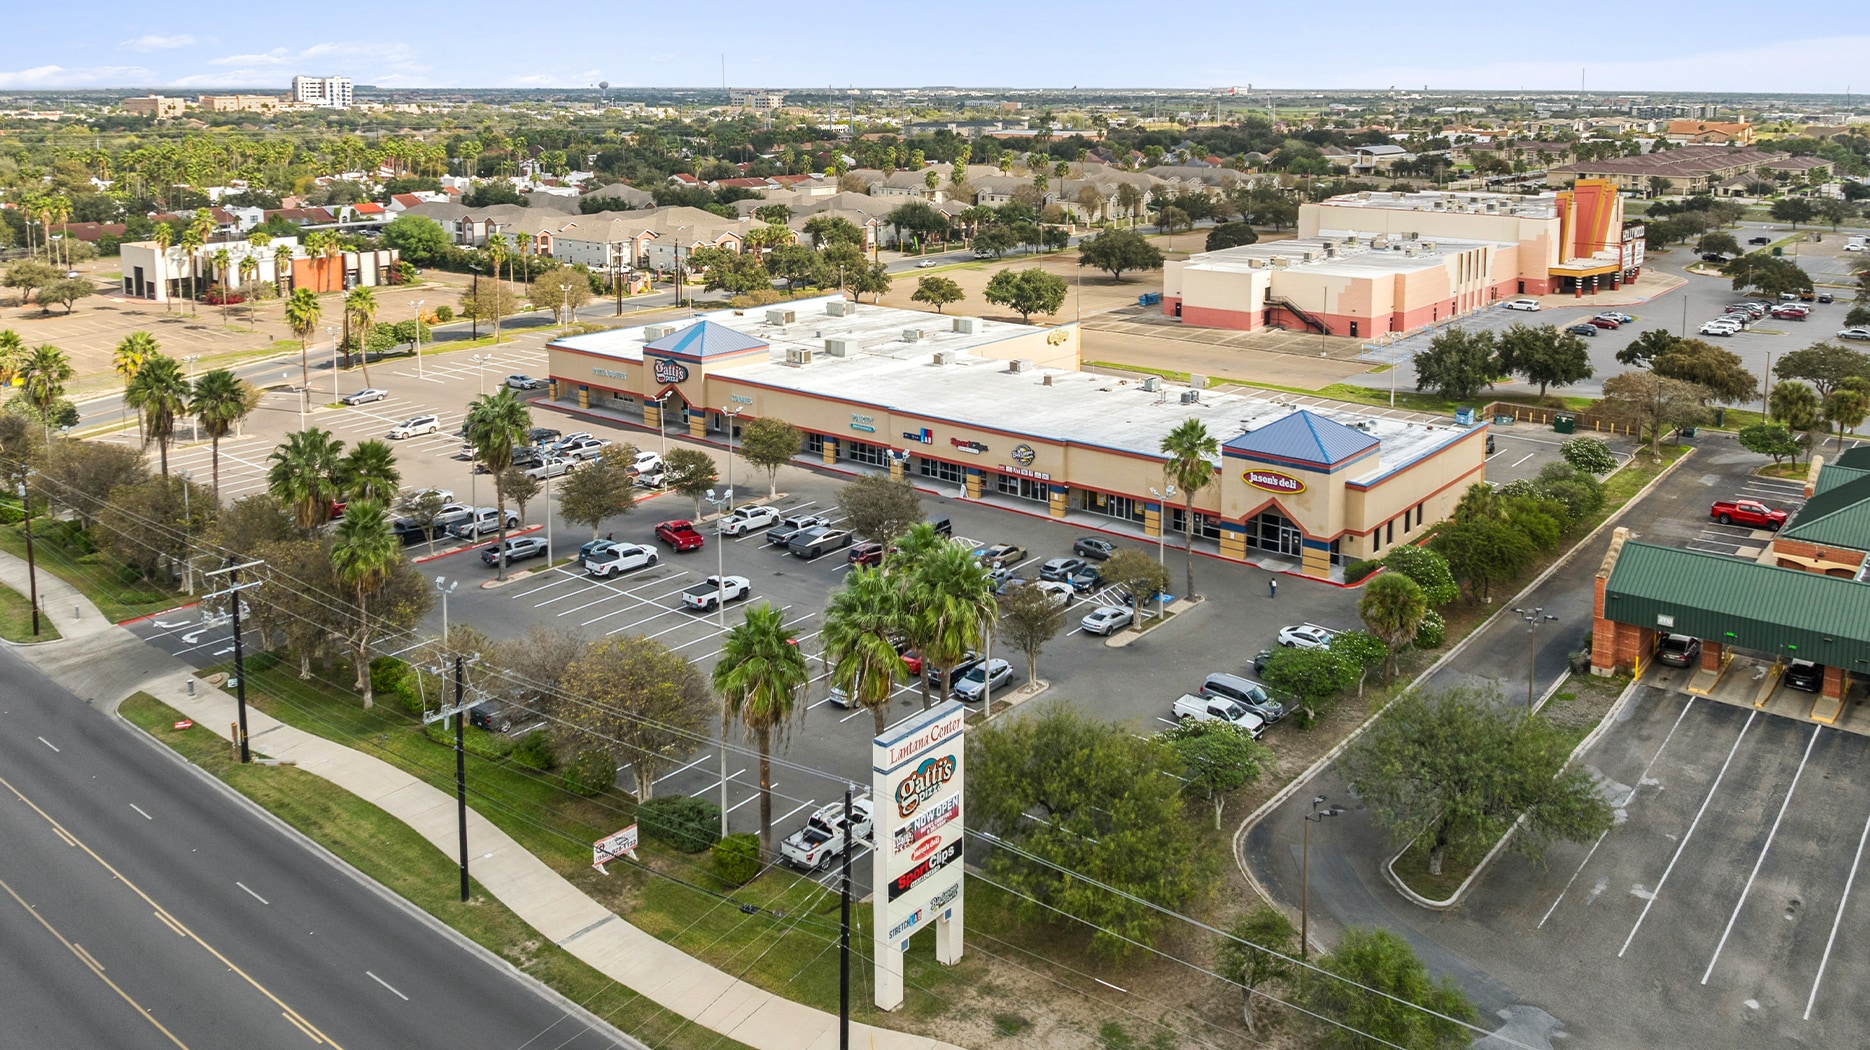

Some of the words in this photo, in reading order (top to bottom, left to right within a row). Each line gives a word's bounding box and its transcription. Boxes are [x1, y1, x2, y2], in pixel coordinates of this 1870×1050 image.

[656, 361, 684, 382] gatti's
[1249, 472, 1278, 486] jason's
[1279, 478, 1297, 490] deli
[890, 734, 929, 765] Lantana
[930, 717, 961, 742] Center
[901, 759, 952, 815] gatti's
[919, 781, 943, 801] pizza
[914, 808, 935, 831] NOW
[936, 794, 959, 817] OPEN
